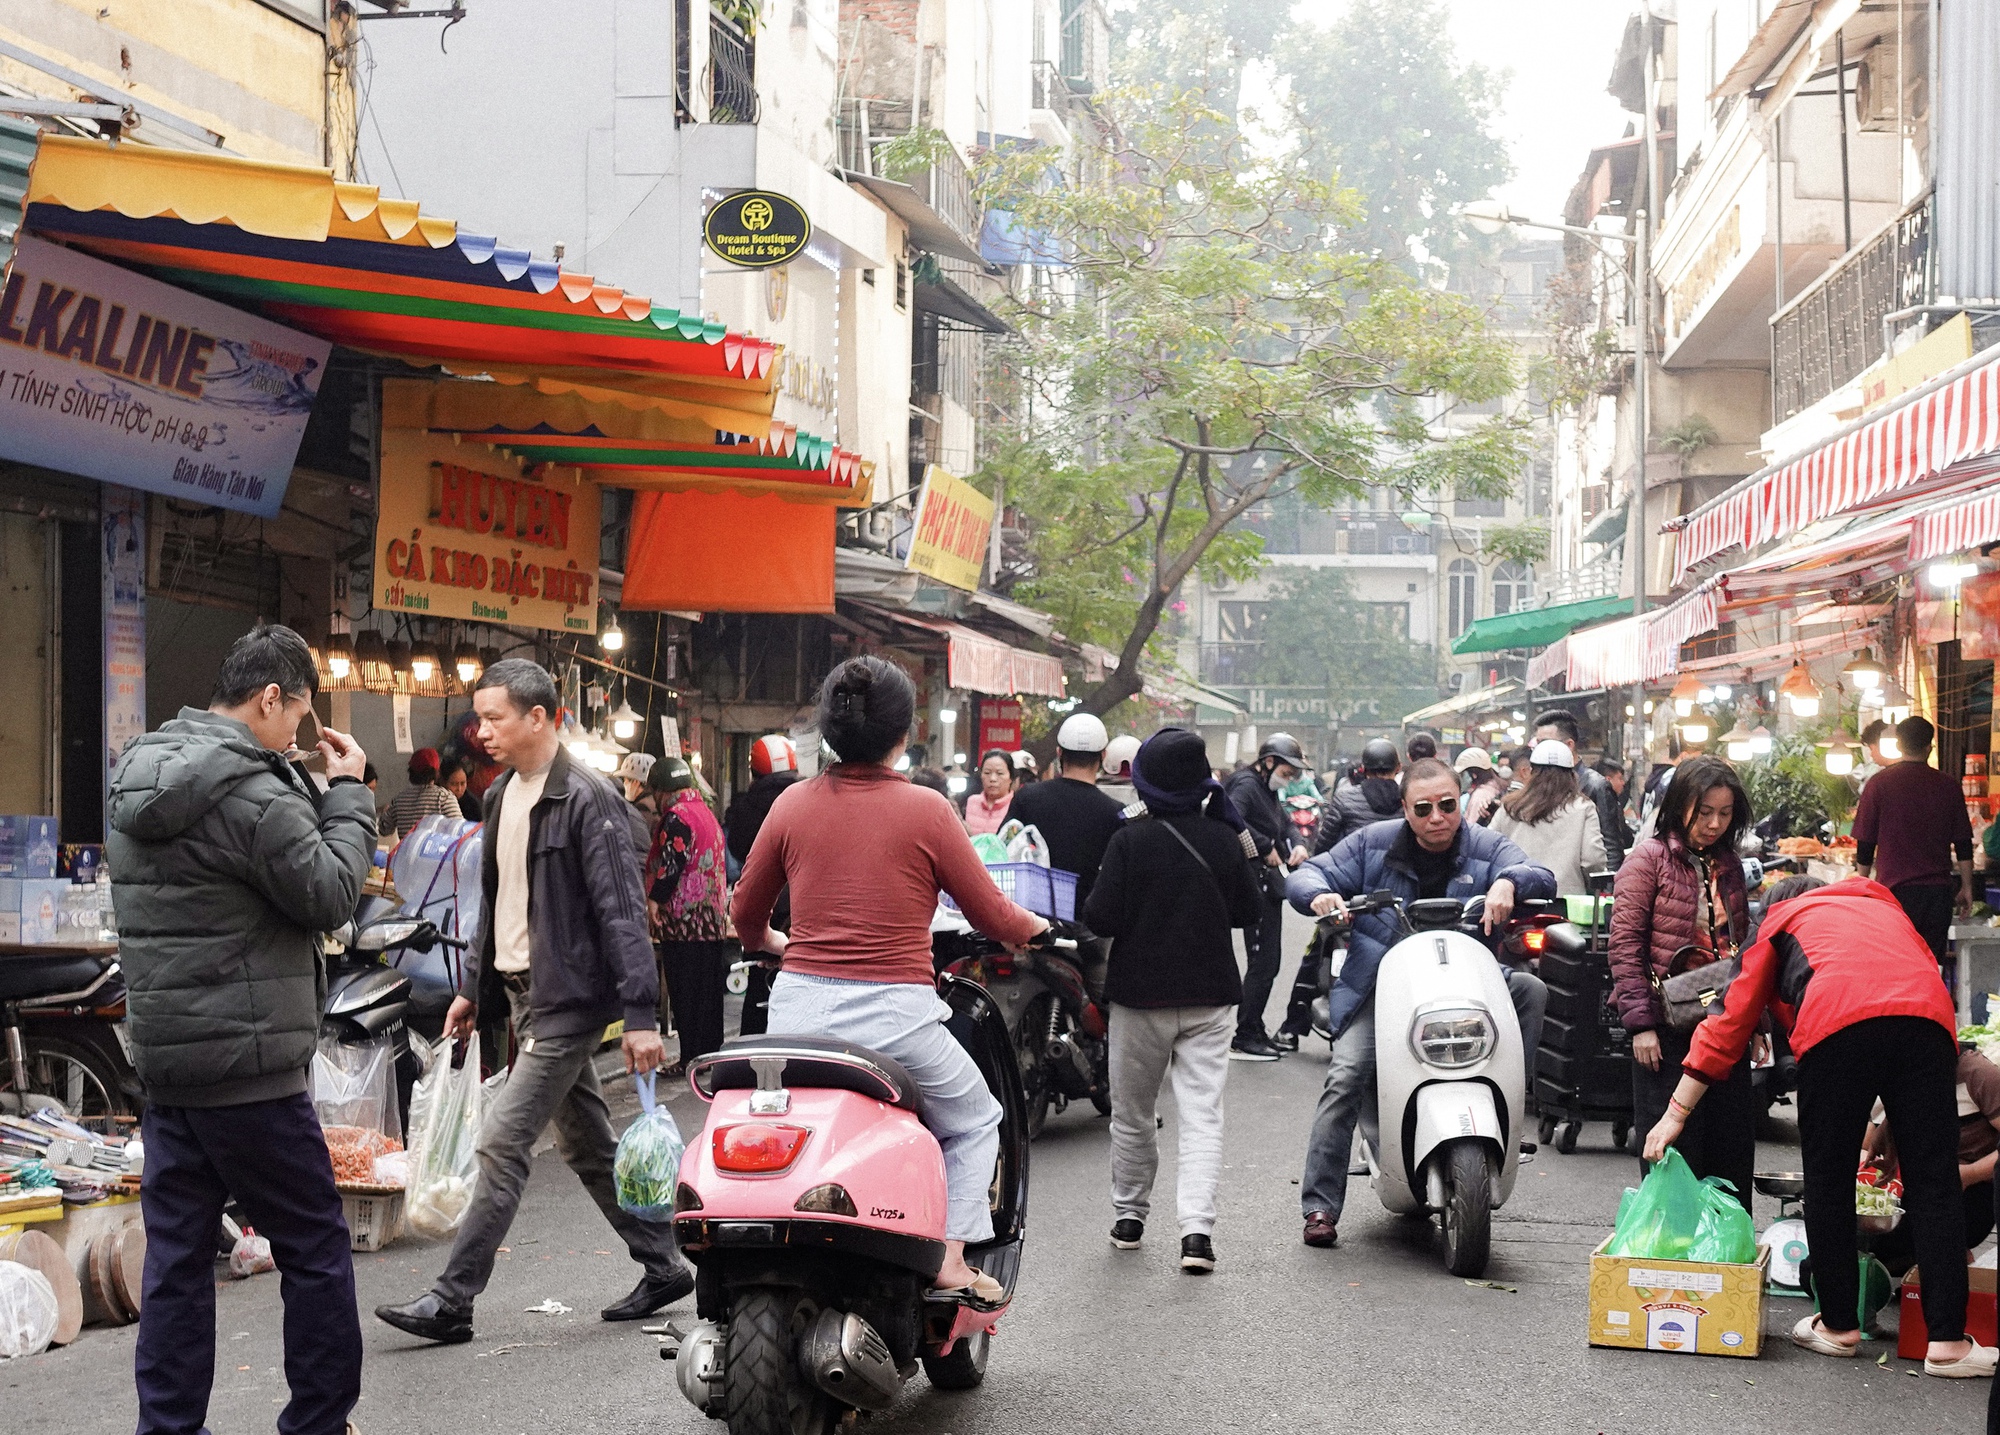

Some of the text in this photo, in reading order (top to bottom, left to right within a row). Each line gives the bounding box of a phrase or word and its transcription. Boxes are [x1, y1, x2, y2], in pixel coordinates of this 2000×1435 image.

[717, 233, 797, 245] Dream Boutique
[727, 245, 786, 257] Hotel & Spa
[11, 370, 60, 406] TÍNH
[61, 386, 108, 421] SINH
[112, 401, 153, 438] HỌC
[152, 414, 181, 445] pH
[173, 456, 200, 485] Giao
[200, 463, 227, 495] Hàng
[387, 528, 427, 582] CÁ
[430, 546, 489, 591] KHO
[870, 1206, 899, 1219] LX125
